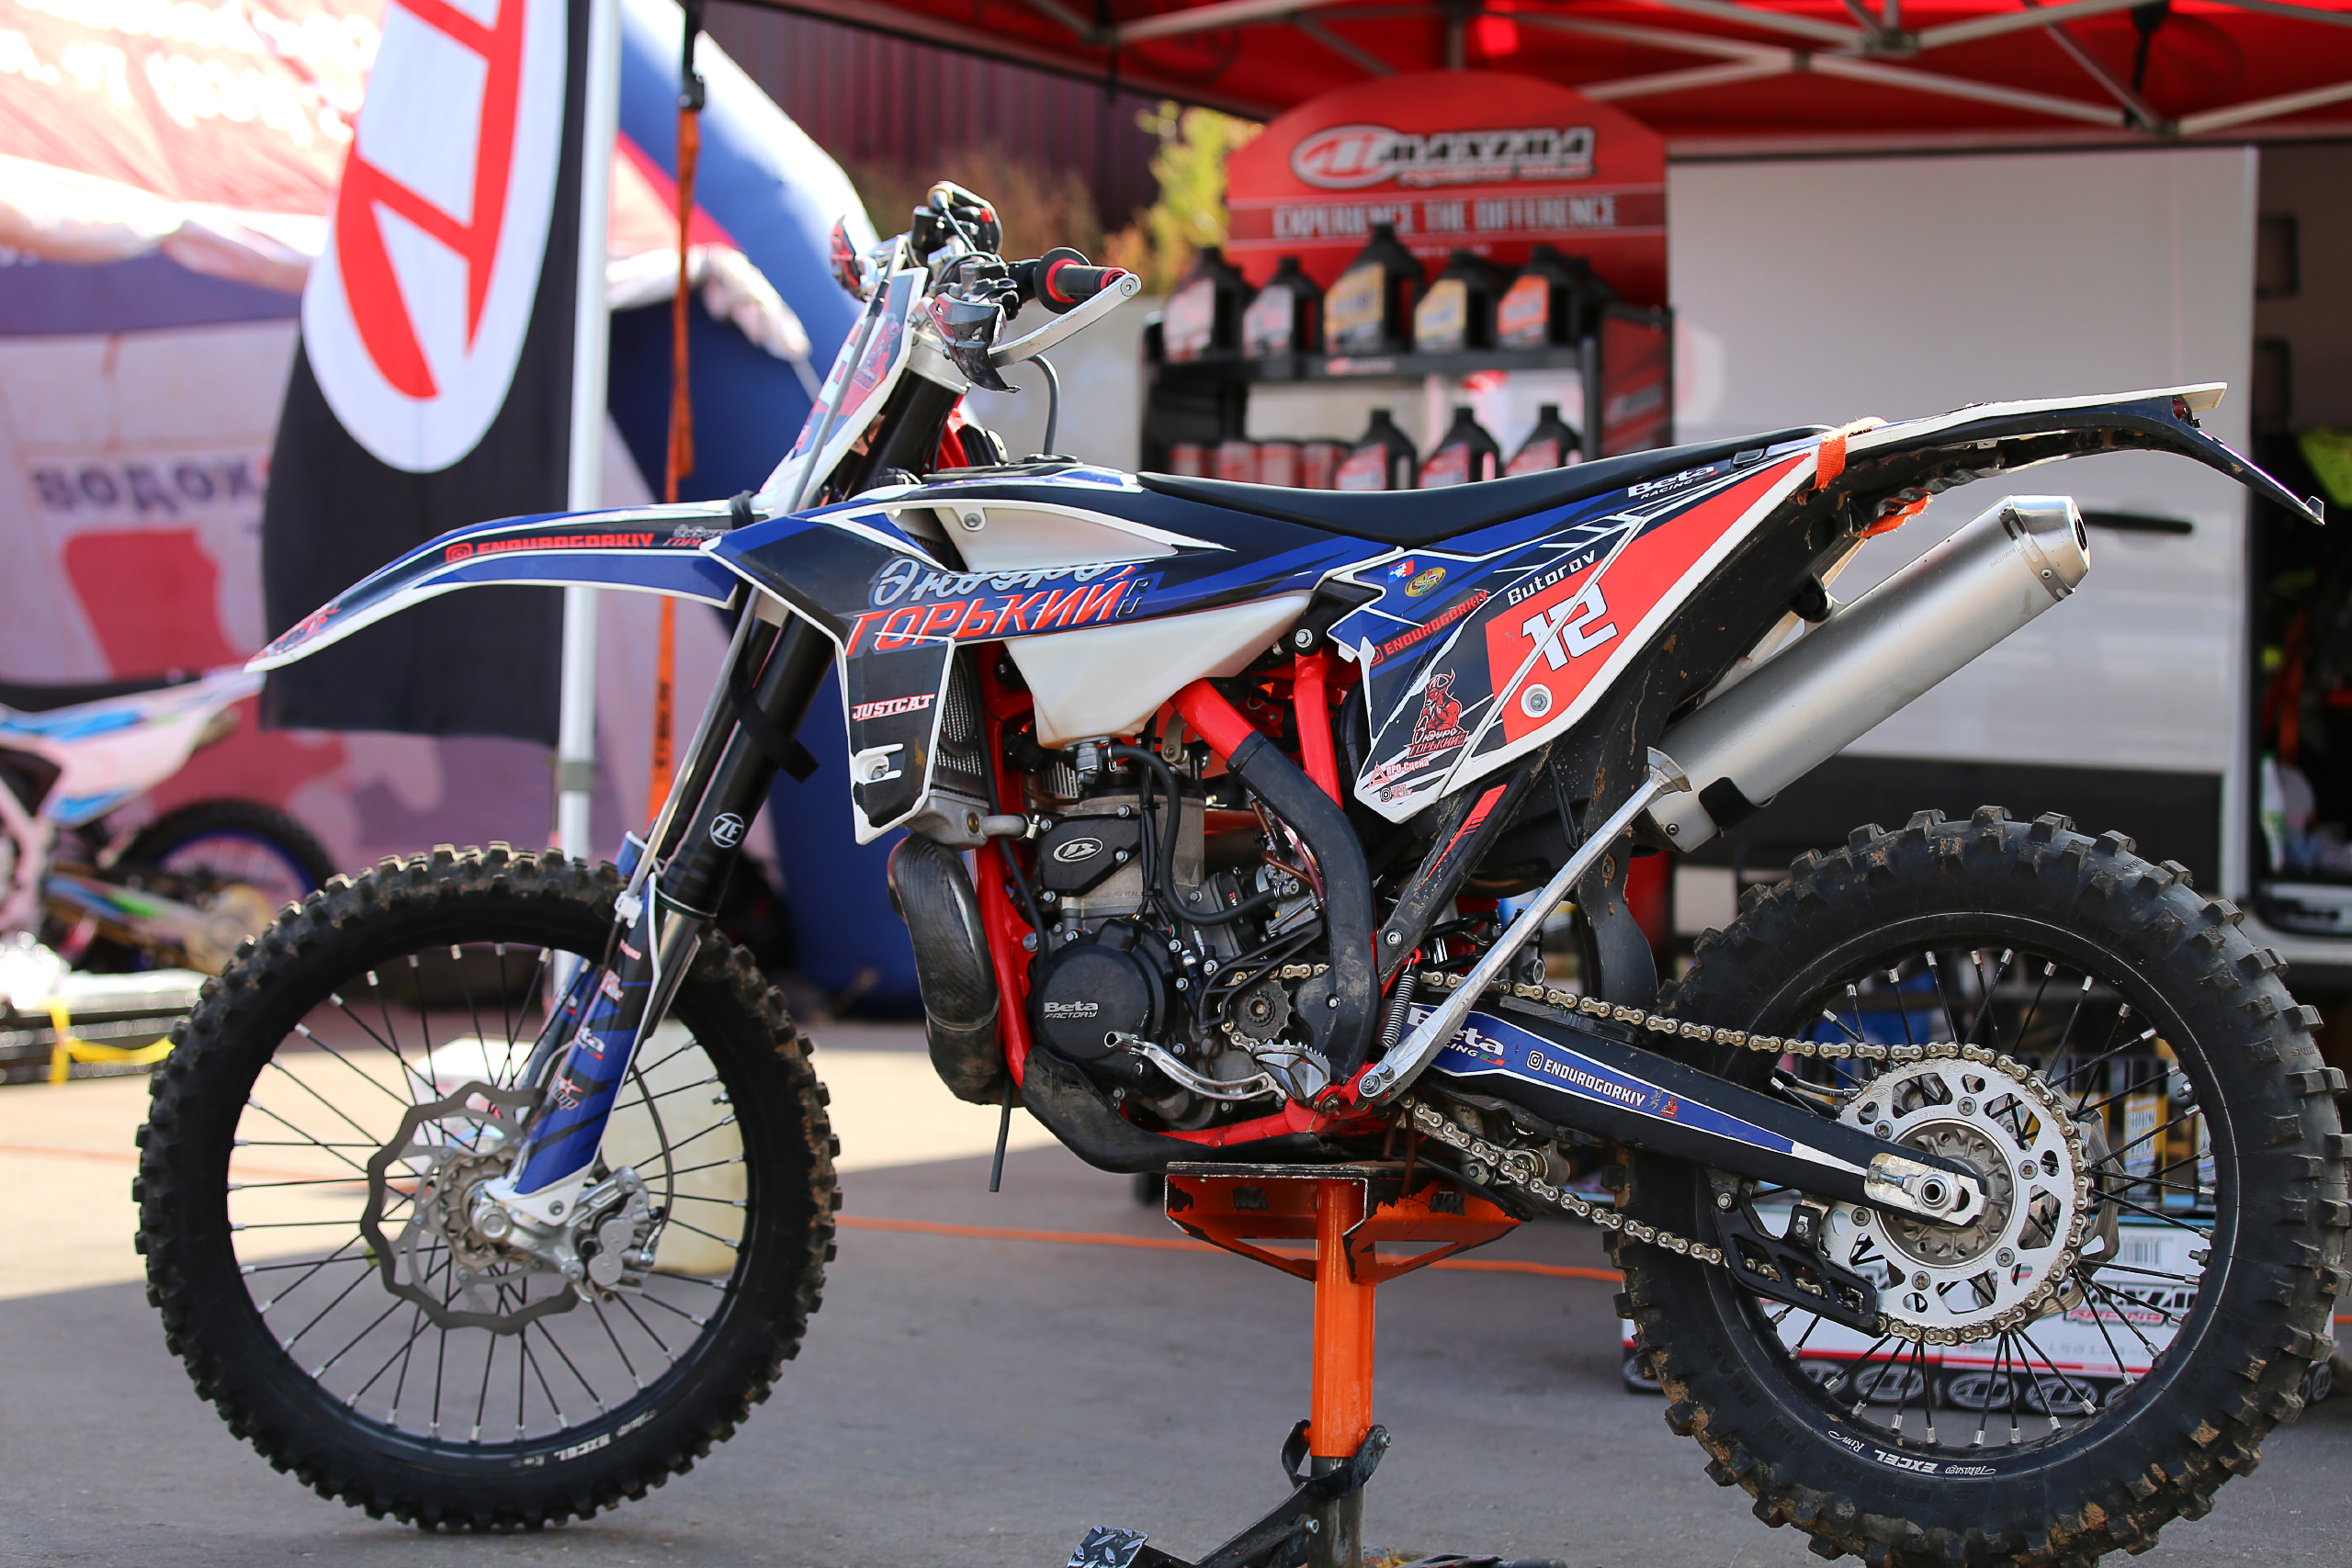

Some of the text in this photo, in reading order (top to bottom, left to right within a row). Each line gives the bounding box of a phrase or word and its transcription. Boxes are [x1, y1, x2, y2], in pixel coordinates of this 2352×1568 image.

[1423, 199, 1464, 232] THE
[1474, 194, 1617, 231] DIFFERENCE
[1628, 466, 1715, 498] Beta
[1640, 479, 1693, 500] RACING
[477, 533, 655, 556] ENDUROGORKIY
[1507, 550, 1596, 606] Butorov
[845, 565, 1136, 657] ГОРЬКИЙ
[1384, 589, 1489, 656] ENDUROGORKIY
[1521, 582, 1619, 671] 12
[851, 694, 935, 722] JUSTCAT
[1044, 1000, 1099, 1013] Beta
[1044, 1010, 1099, 1019] FACTORY
[1543, 1058, 1646, 1108] ENDUROGORKIY
[1874, 1449, 1939, 1474] EXCEL
